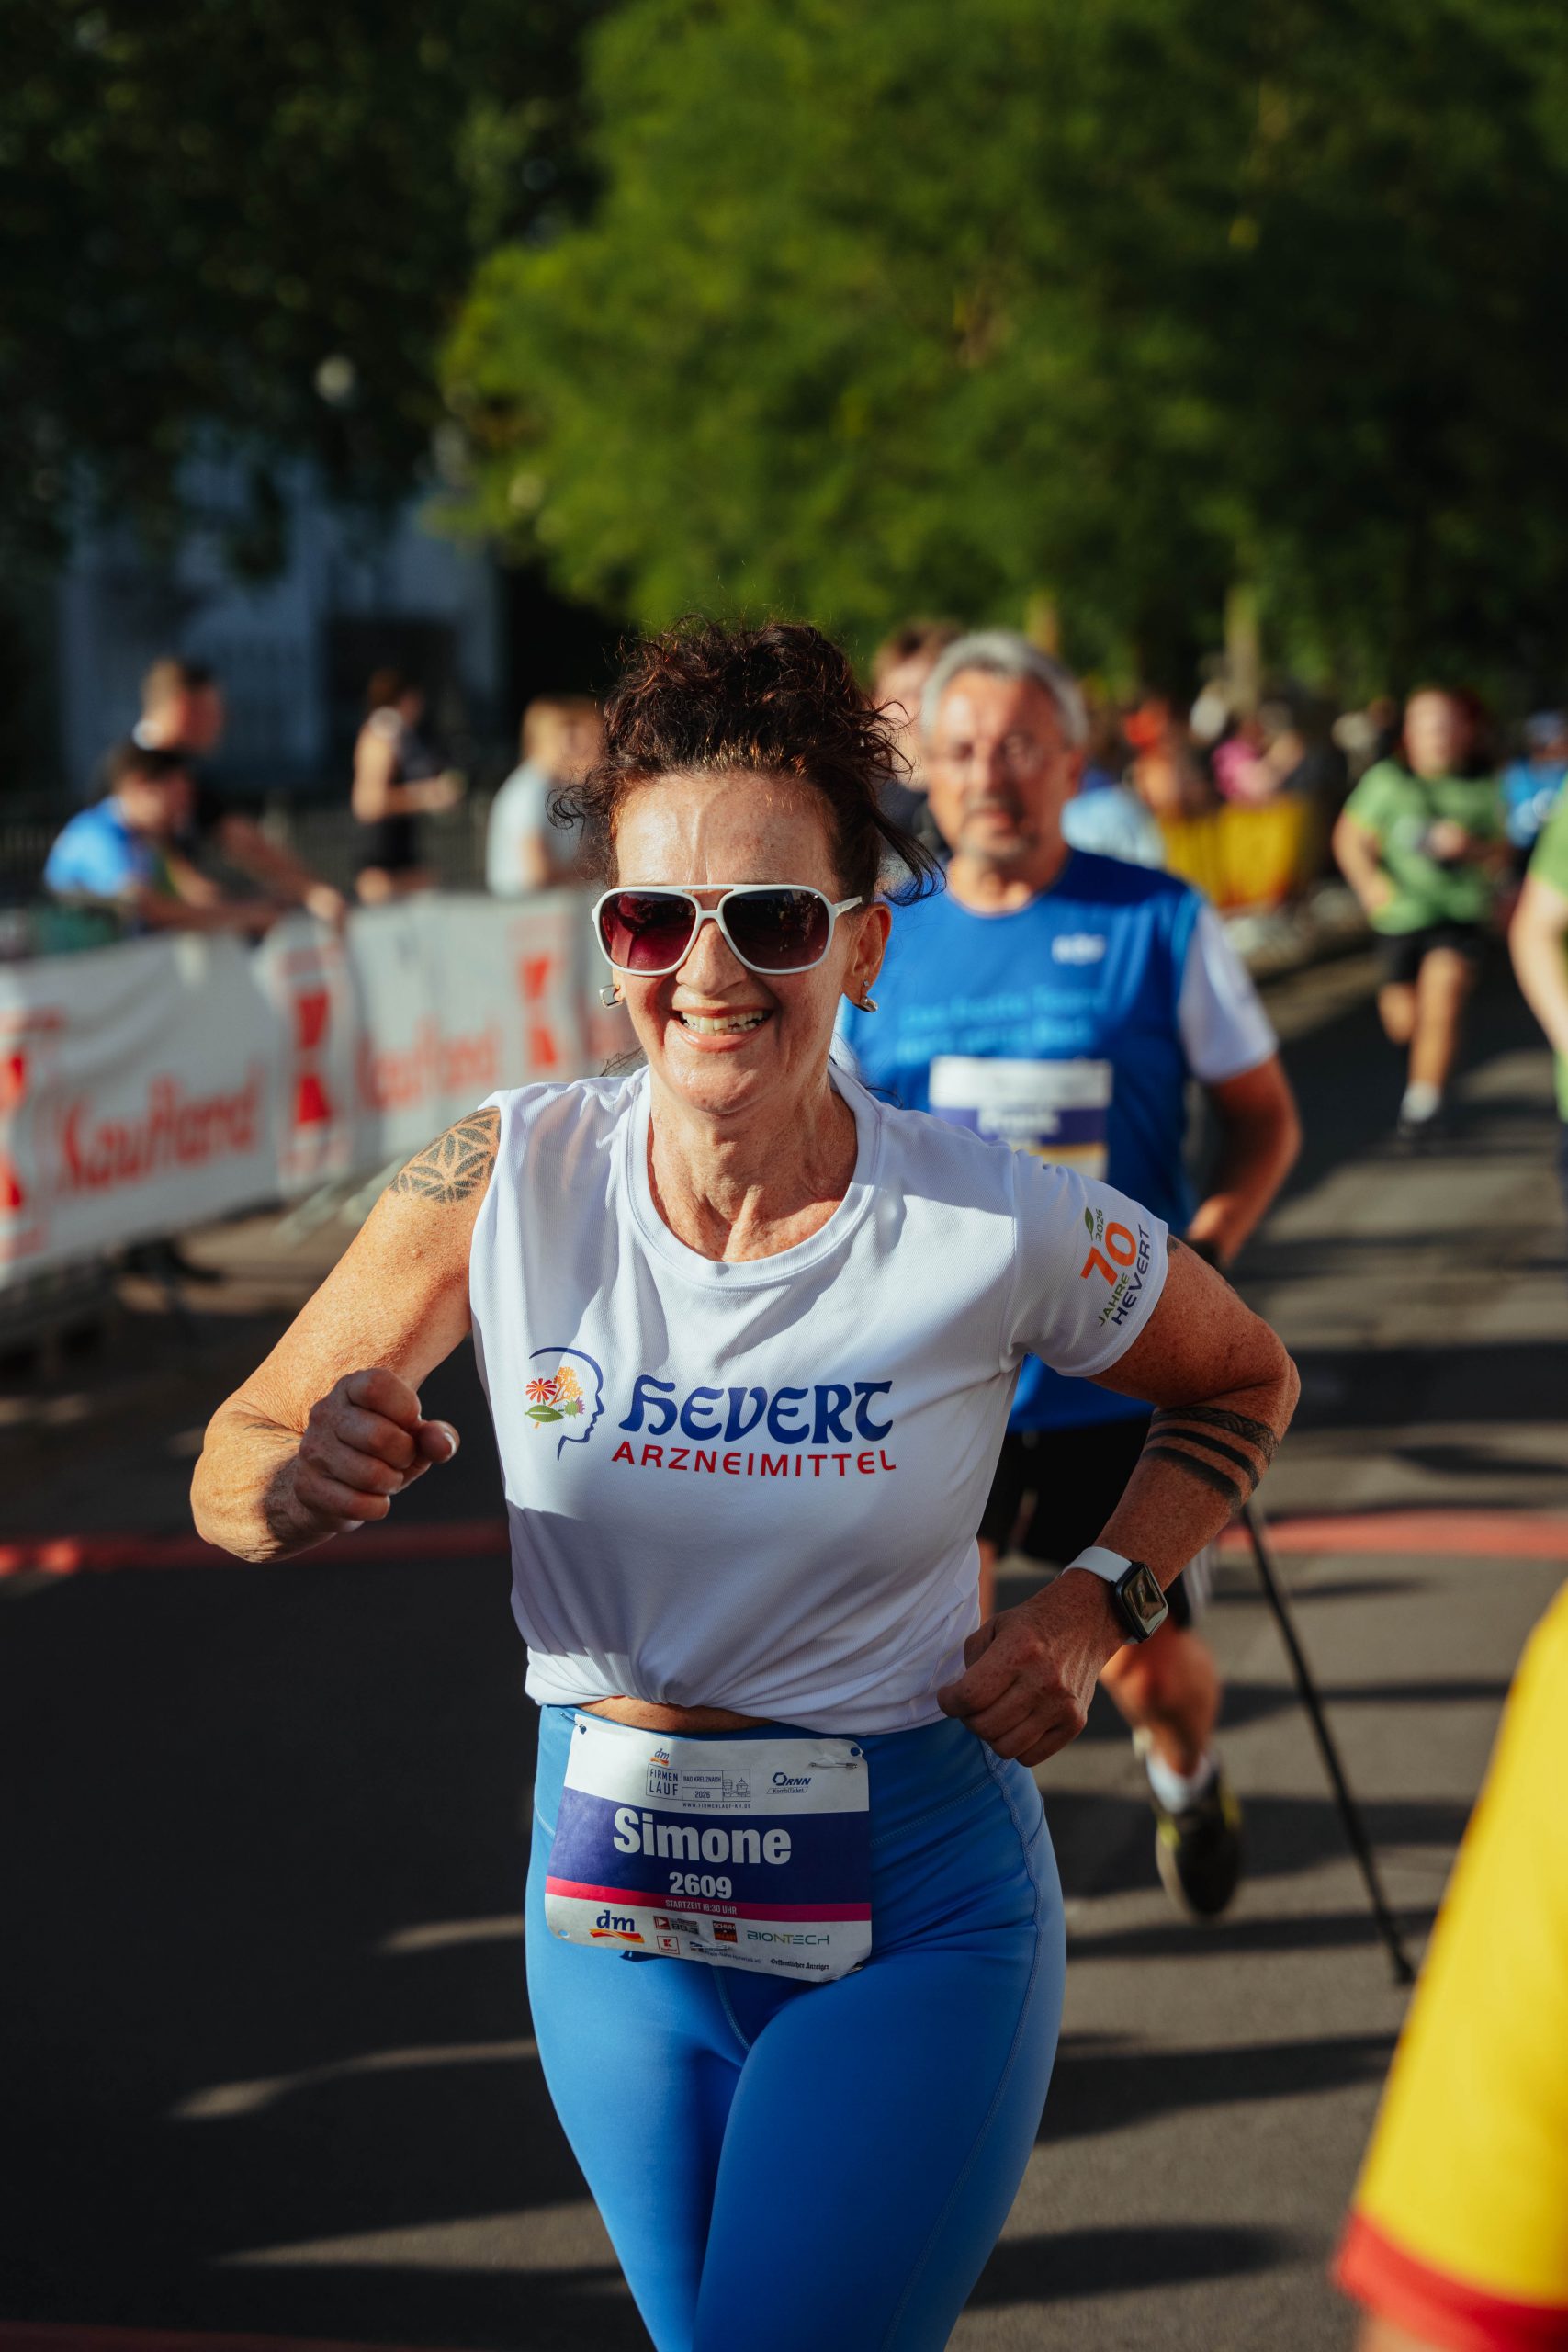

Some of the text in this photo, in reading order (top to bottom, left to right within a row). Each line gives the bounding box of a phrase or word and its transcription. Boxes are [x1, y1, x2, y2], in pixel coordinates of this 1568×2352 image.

[1095, 1208, 1104, 1242] 2026
[1080, 1222, 1137, 1286] 70
[1111, 1224, 1151, 1326] HEVERT
[1097, 1272, 1130, 1327] JAHRE
[611, 1441, 897, 1476] ARZNEIMITTEL
[649, 1780, 679, 1796] LAUF
[650, 1769, 679, 1781] FIRMEN
[683, 1774, 693, 1782] BAD
[694, 1791, 711, 1799] 2026
[613, 1807, 792, 1865] Simone
[669, 1871, 733, 1900] 2609
[665, 1899, 701, 1910] STARTZEIT
[722, 1905, 737, 1915] UHR
[596, 1909, 636, 1932] dm
[746, 1930, 829, 1945] BIONTECH
